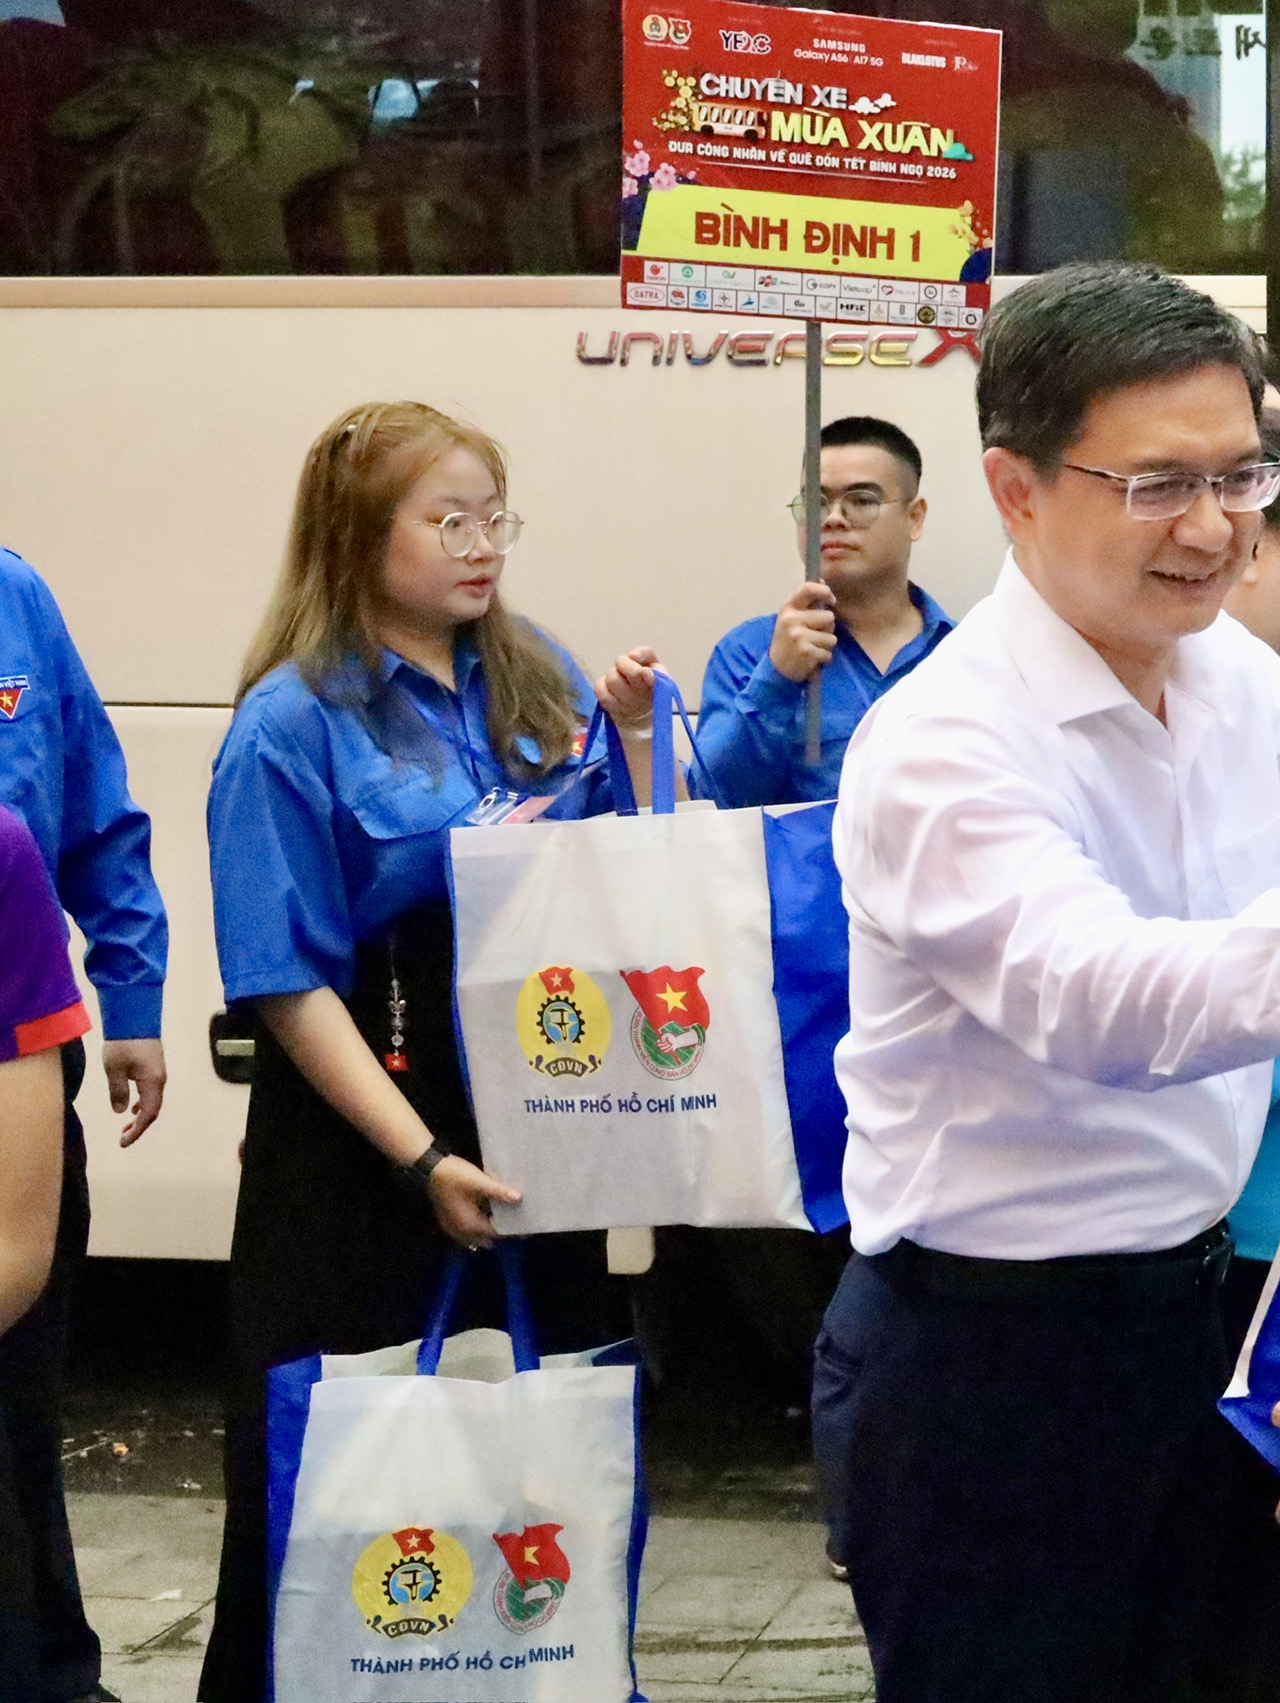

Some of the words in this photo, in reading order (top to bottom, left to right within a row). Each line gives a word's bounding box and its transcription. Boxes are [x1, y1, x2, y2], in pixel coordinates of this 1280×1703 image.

[813, 38, 866, 53] SAMSUNG
[794, 49, 830, 62] Galaxy
[830, 51, 848, 62] A56
[870, 57, 884, 67] 5G
[811, 84, 848, 109] XE
[771, 107, 849, 148] MÙA
[857, 119, 954, 157] XUÂN
[697, 143, 729, 158] CÔNG
[733, 146, 766, 161] NHÂN
[927, 165, 957, 179] 2026
[695, 202, 788, 252] BÌNH
[803, 220, 895, 266] ĐỊNH
[910, 230, 921, 262] 1
[634, 290, 659, 299] SATRA
[550, 1059, 583, 1075] CĐVN
[524, 1094, 575, 1113] THÀNH
[580, 1093, 612, 1113] PHỐ
[618, 1092, 641, 1113] HỒ
[647, 1094, 675, 1113] CHÍ
[681, 1094, 717, 1112] MINH
[387, 1621, 429, 1637] CĐVN
[350, 1656, 413, 1674] THÀNH
[419, 1650, 460, 1671] PHỐ
[529, 1644, 575, 1664] MINH
